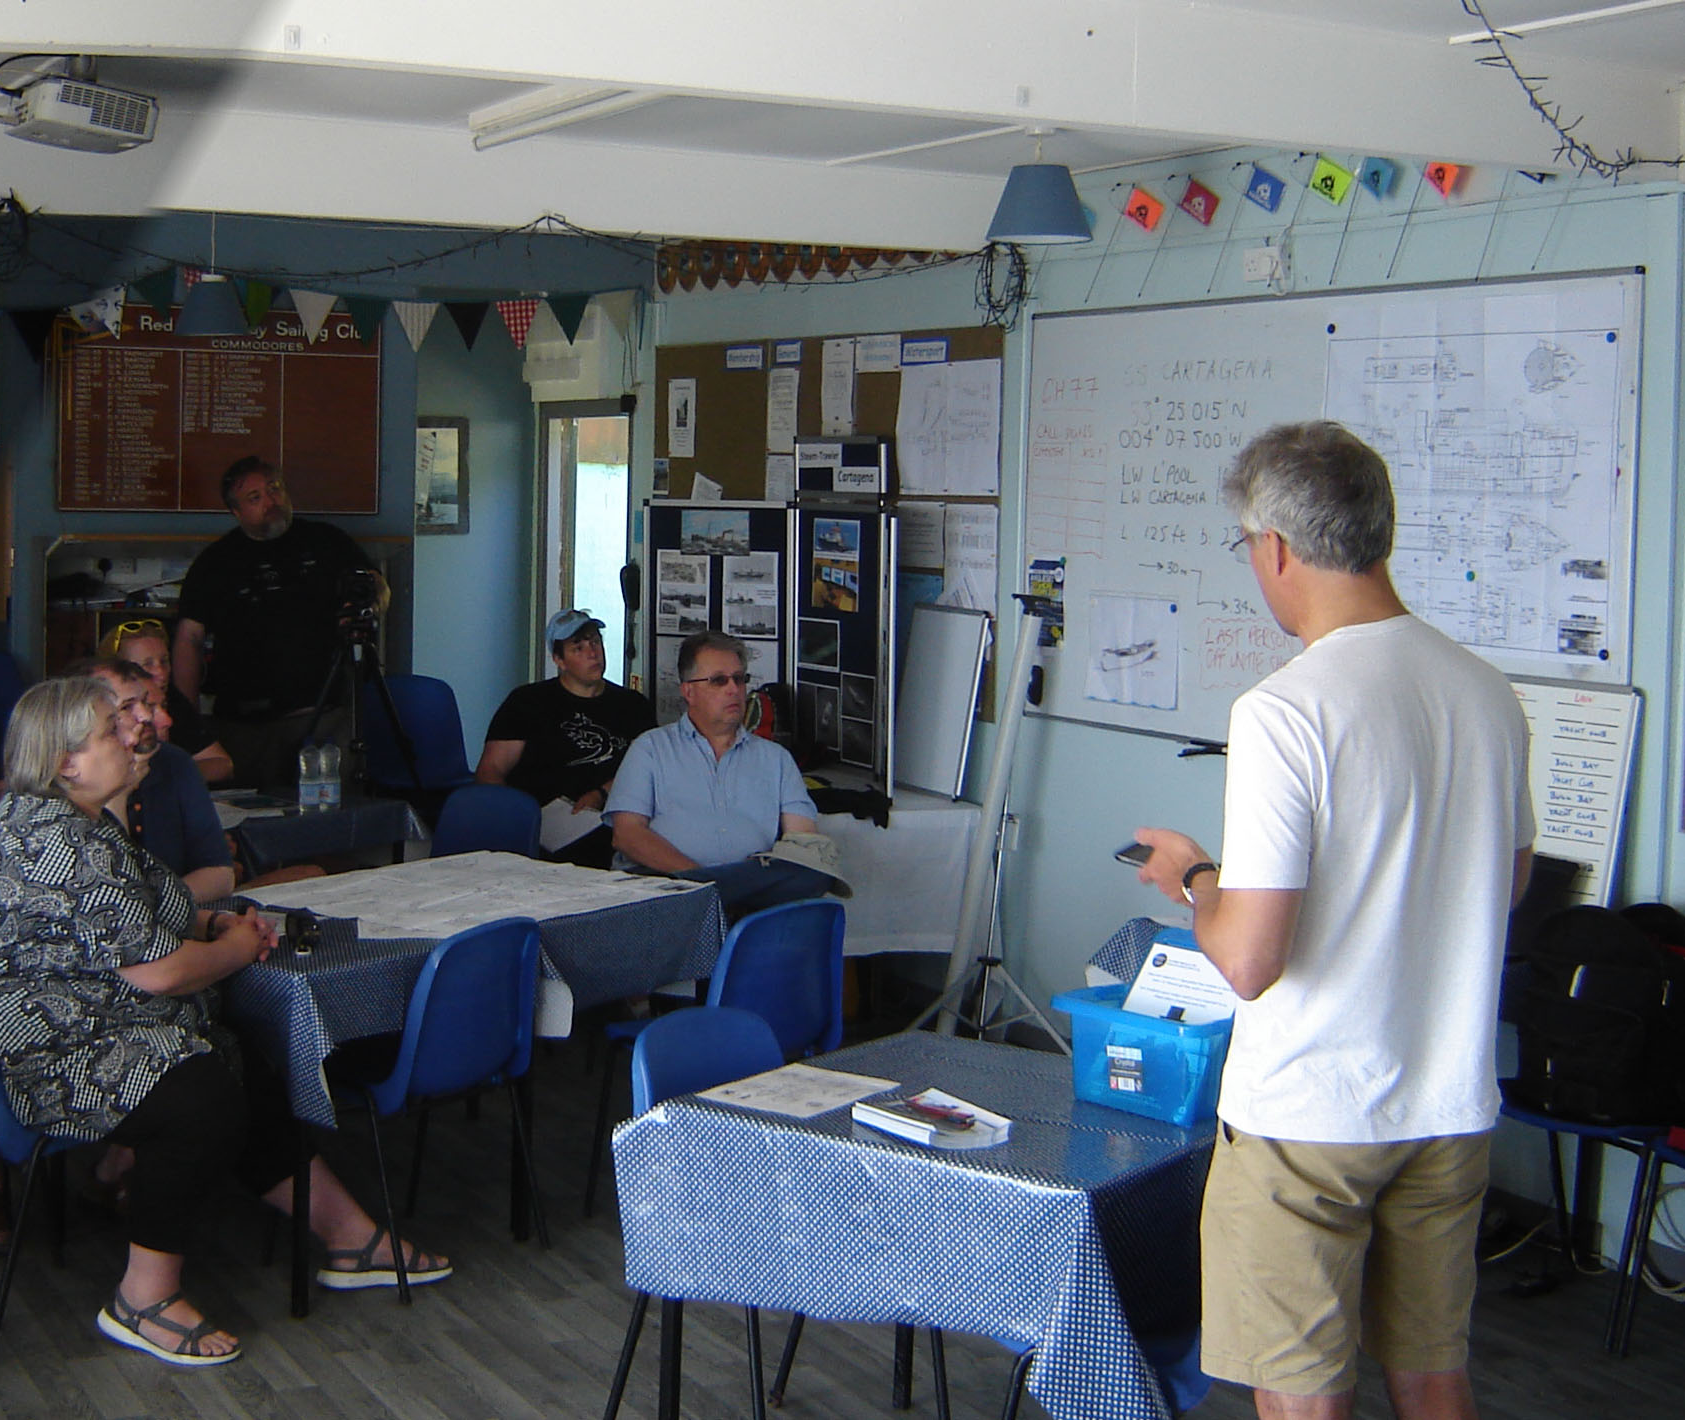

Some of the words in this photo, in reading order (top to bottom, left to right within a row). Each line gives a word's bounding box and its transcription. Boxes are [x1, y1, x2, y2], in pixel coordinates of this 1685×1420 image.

[140, 315, 173, 332] Red
[274, 320, 329, 342] Sailg
[335, 323, 362, 341] Clu
[211, 340, 305, 352] COMMODORES
[1162, 360, 1275, 382] CARTAGENA
[837, 470, 874, 487] Cartagena
[1122, 464, 1143, 485] LW
[1205, 627, 1243, 647] LAST
